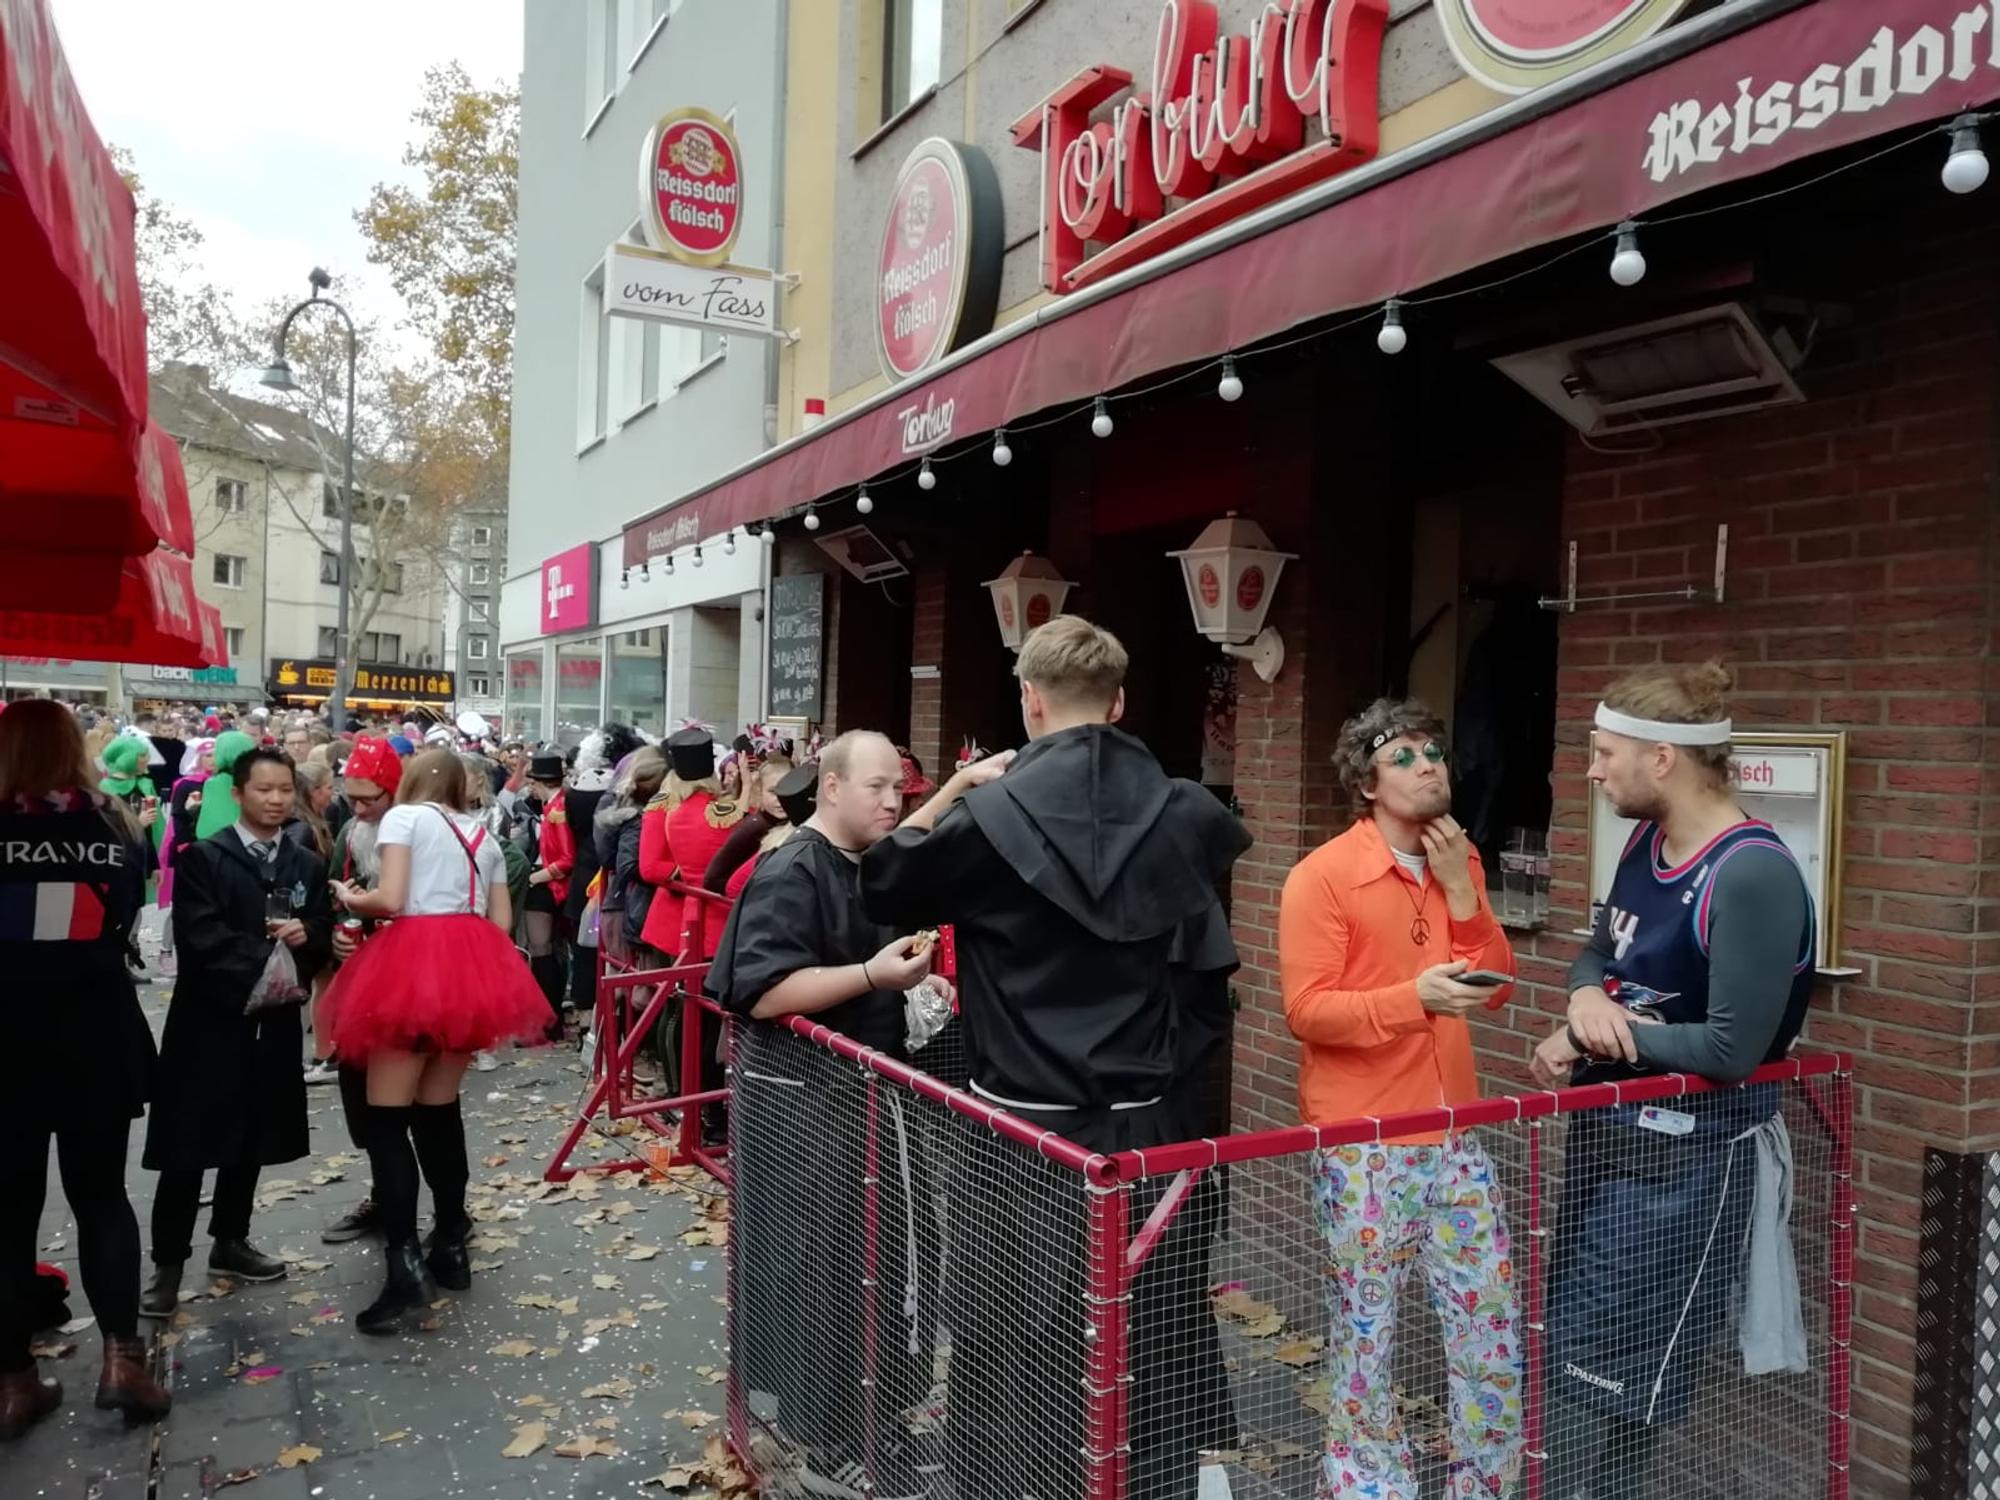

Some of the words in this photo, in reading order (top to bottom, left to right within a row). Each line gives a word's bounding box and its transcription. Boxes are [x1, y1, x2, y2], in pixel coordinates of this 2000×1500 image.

[1009, 0, 1391, 295] Torburg
[657, 168, 738, 205] Reissdorf
[668, 199, 725, 233] Kölsch
[884, 230, 953, 304] Reissdorf
[623, 281, 695, 307] vom
[702, 276, 766, 320] Fass
[0, 841, 124, 867] RANCE
